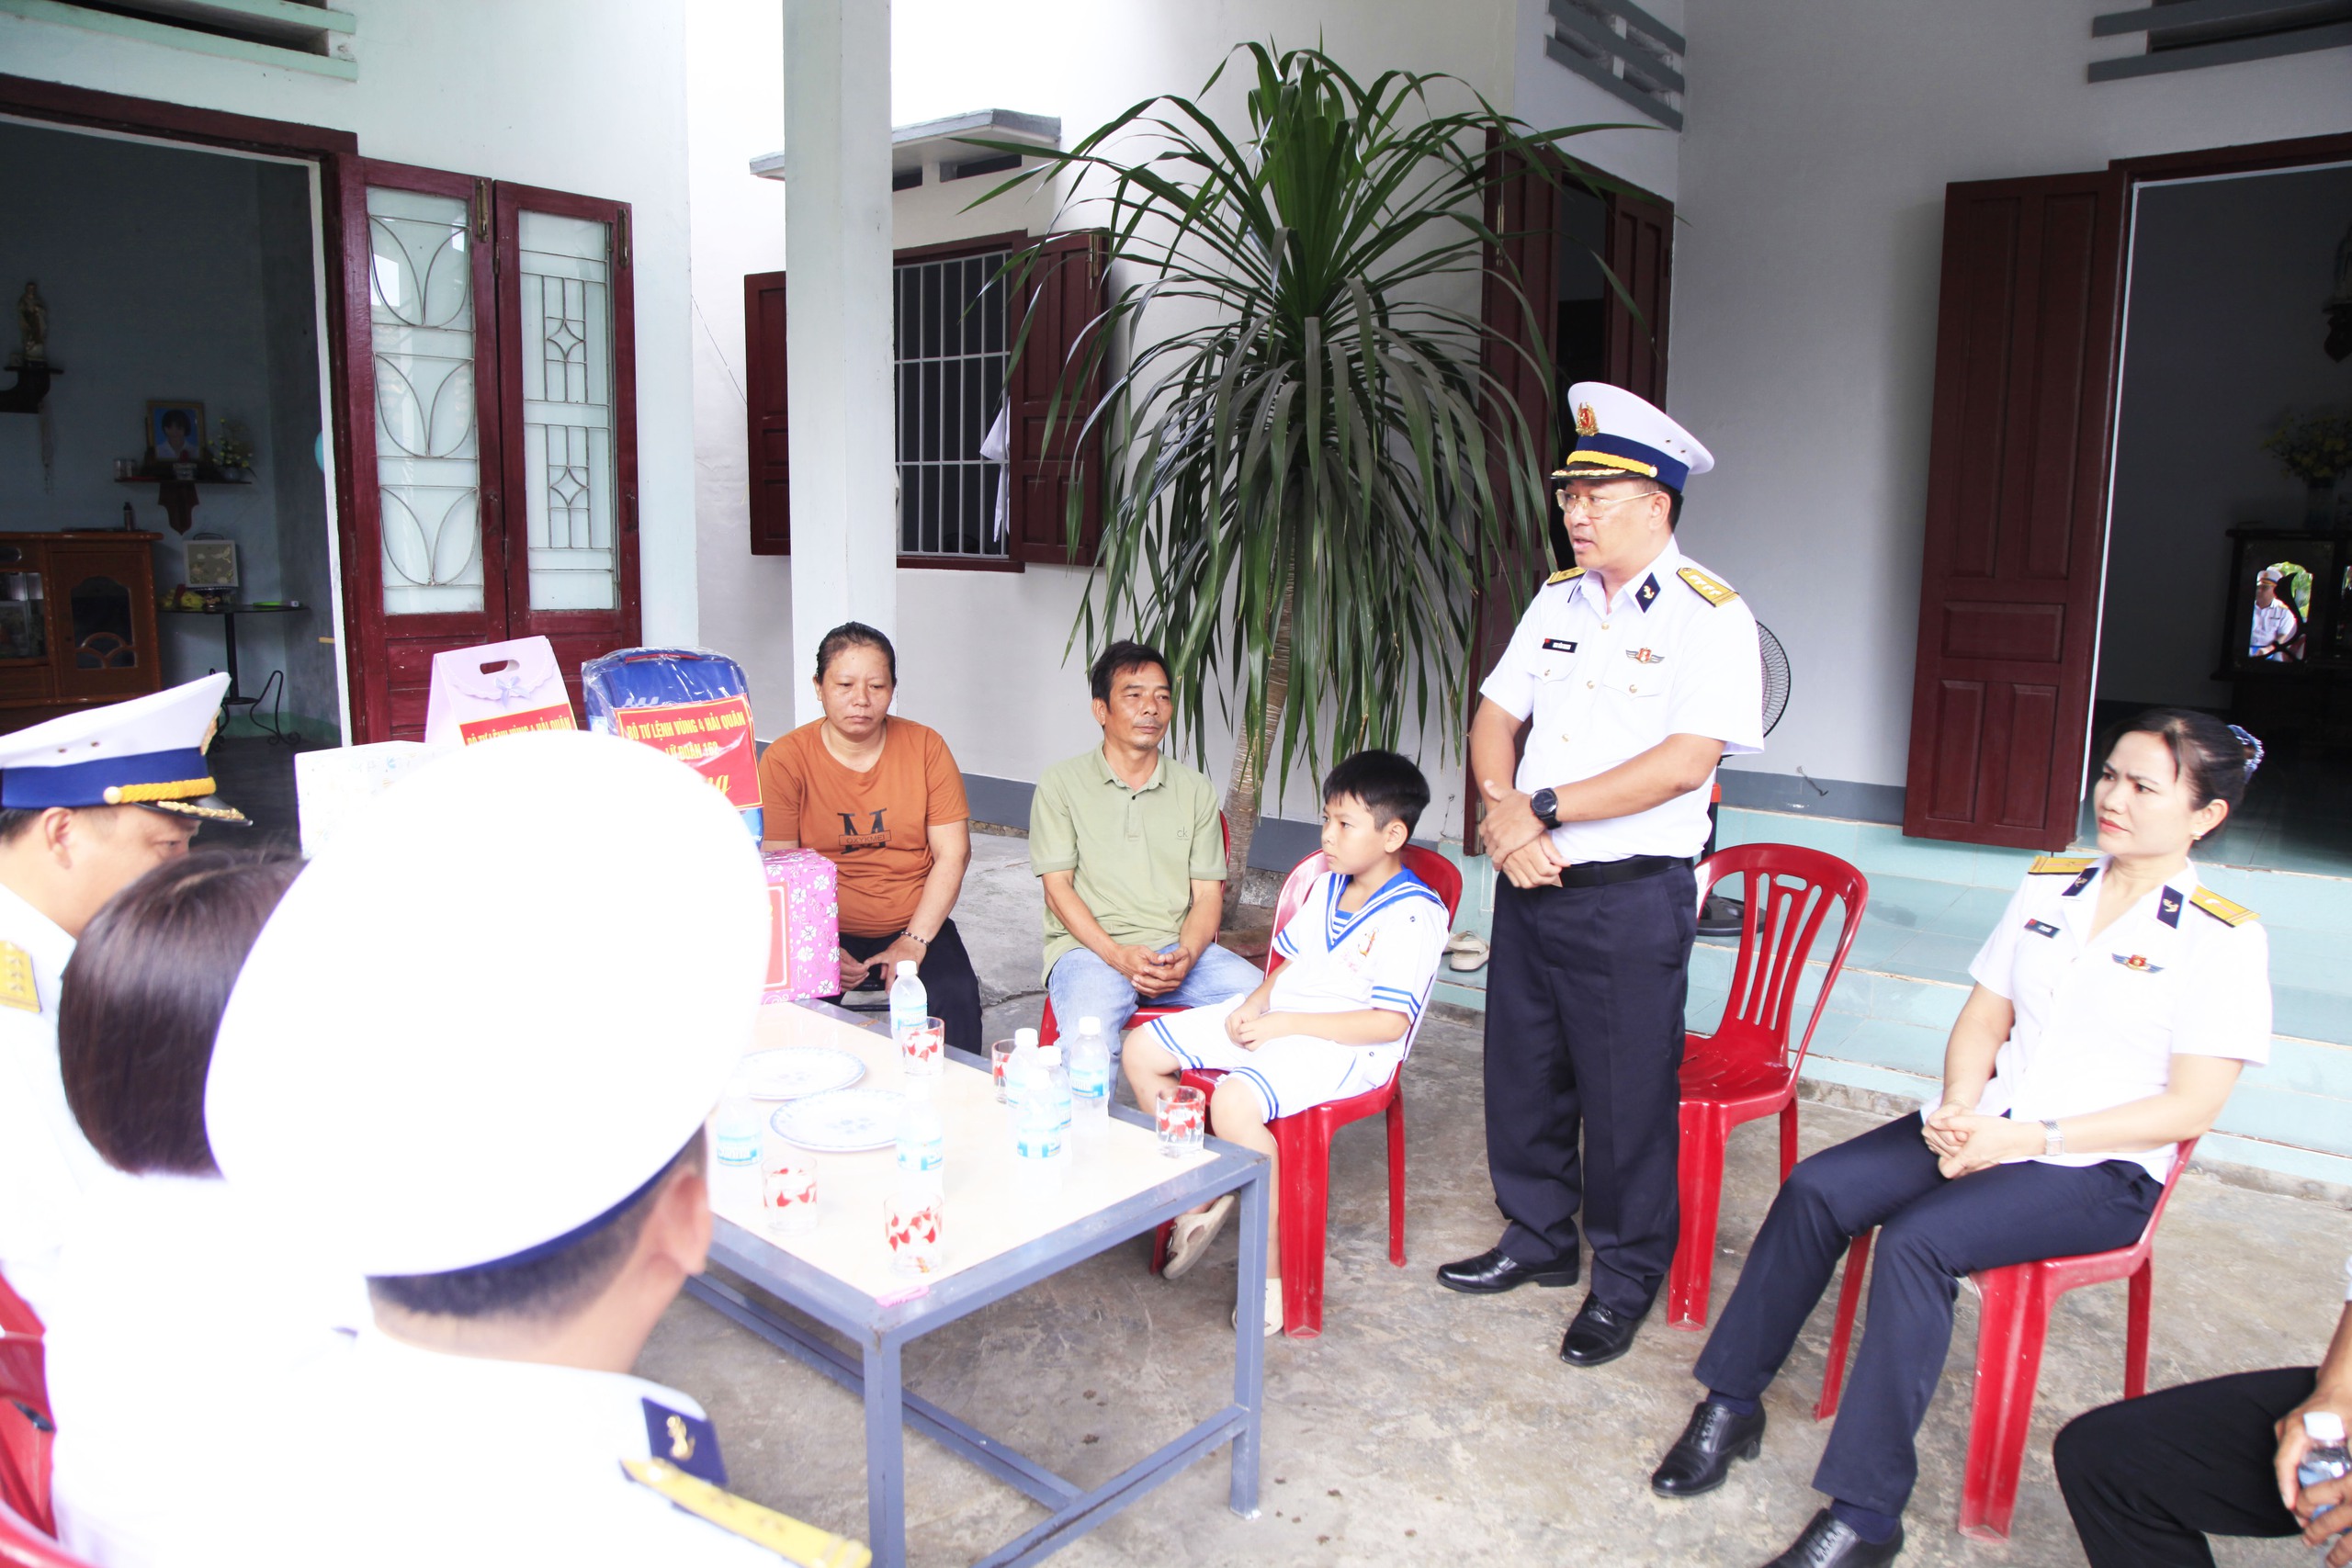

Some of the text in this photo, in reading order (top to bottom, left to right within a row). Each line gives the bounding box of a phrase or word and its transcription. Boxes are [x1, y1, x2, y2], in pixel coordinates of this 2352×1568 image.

[627, 721, 639, 741] BỘ
[651, 719, 674, 740] LỆNH
[673, 716, 698, 734] VÙNG
[698, 717, 705, 732] 4
[704, 712, 721, 731] HẢI
[721, 710, 746, 729] QUÂN
[702, 740, 720, 757] 162
[1176, 826, 1189, 837] ck
